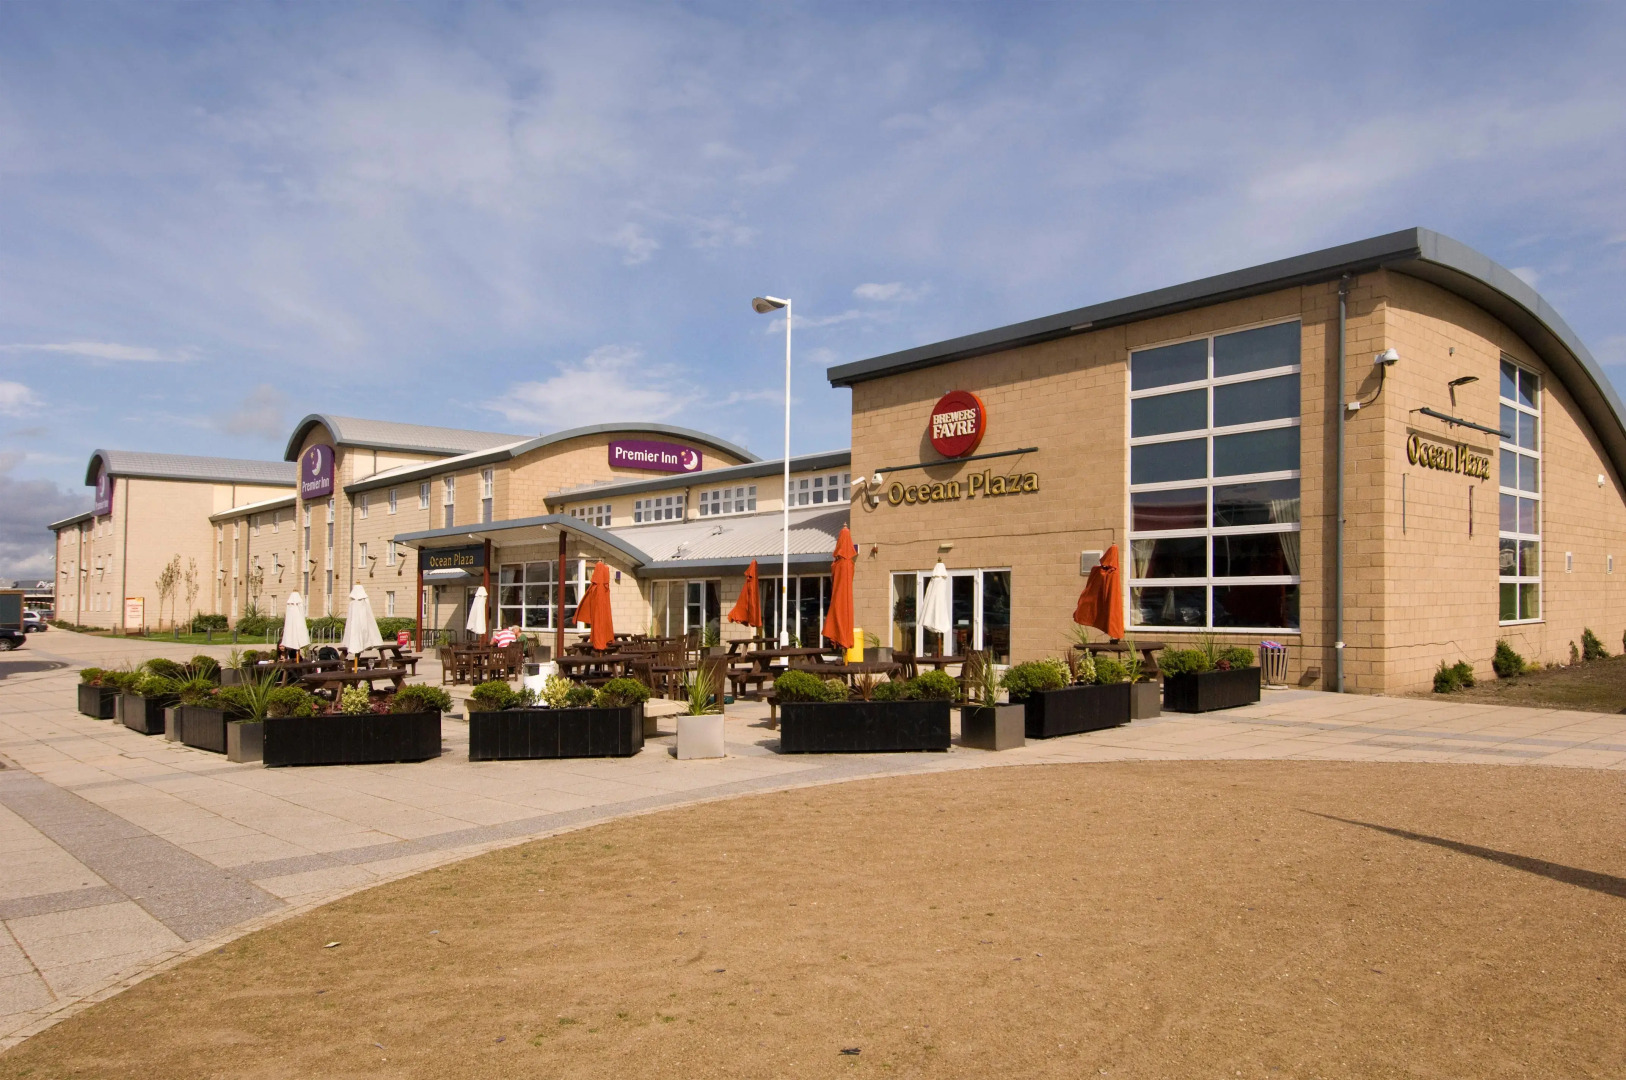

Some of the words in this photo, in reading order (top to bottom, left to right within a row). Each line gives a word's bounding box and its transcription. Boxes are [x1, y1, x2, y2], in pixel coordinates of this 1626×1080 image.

[933, 408, 976, 425] BREWERS
[933, 419, 976, 439] FAYRE
[615, 446, 660, 463] Premier
[661, 451, 678, 465] Inn
[1407, 432, 1454, 472] Ocean
[1455, 443, 1490, 480] Plaza
[302, 478, 321, 493] Premier
[321, 476, 330, 489] Inn
[887, 480, 961, 505] Ocean
[967, 468, 1039, 497] Plaza
[430, 555, 452, 567] Ocean
[453, 552, 474, 566] Plaza
